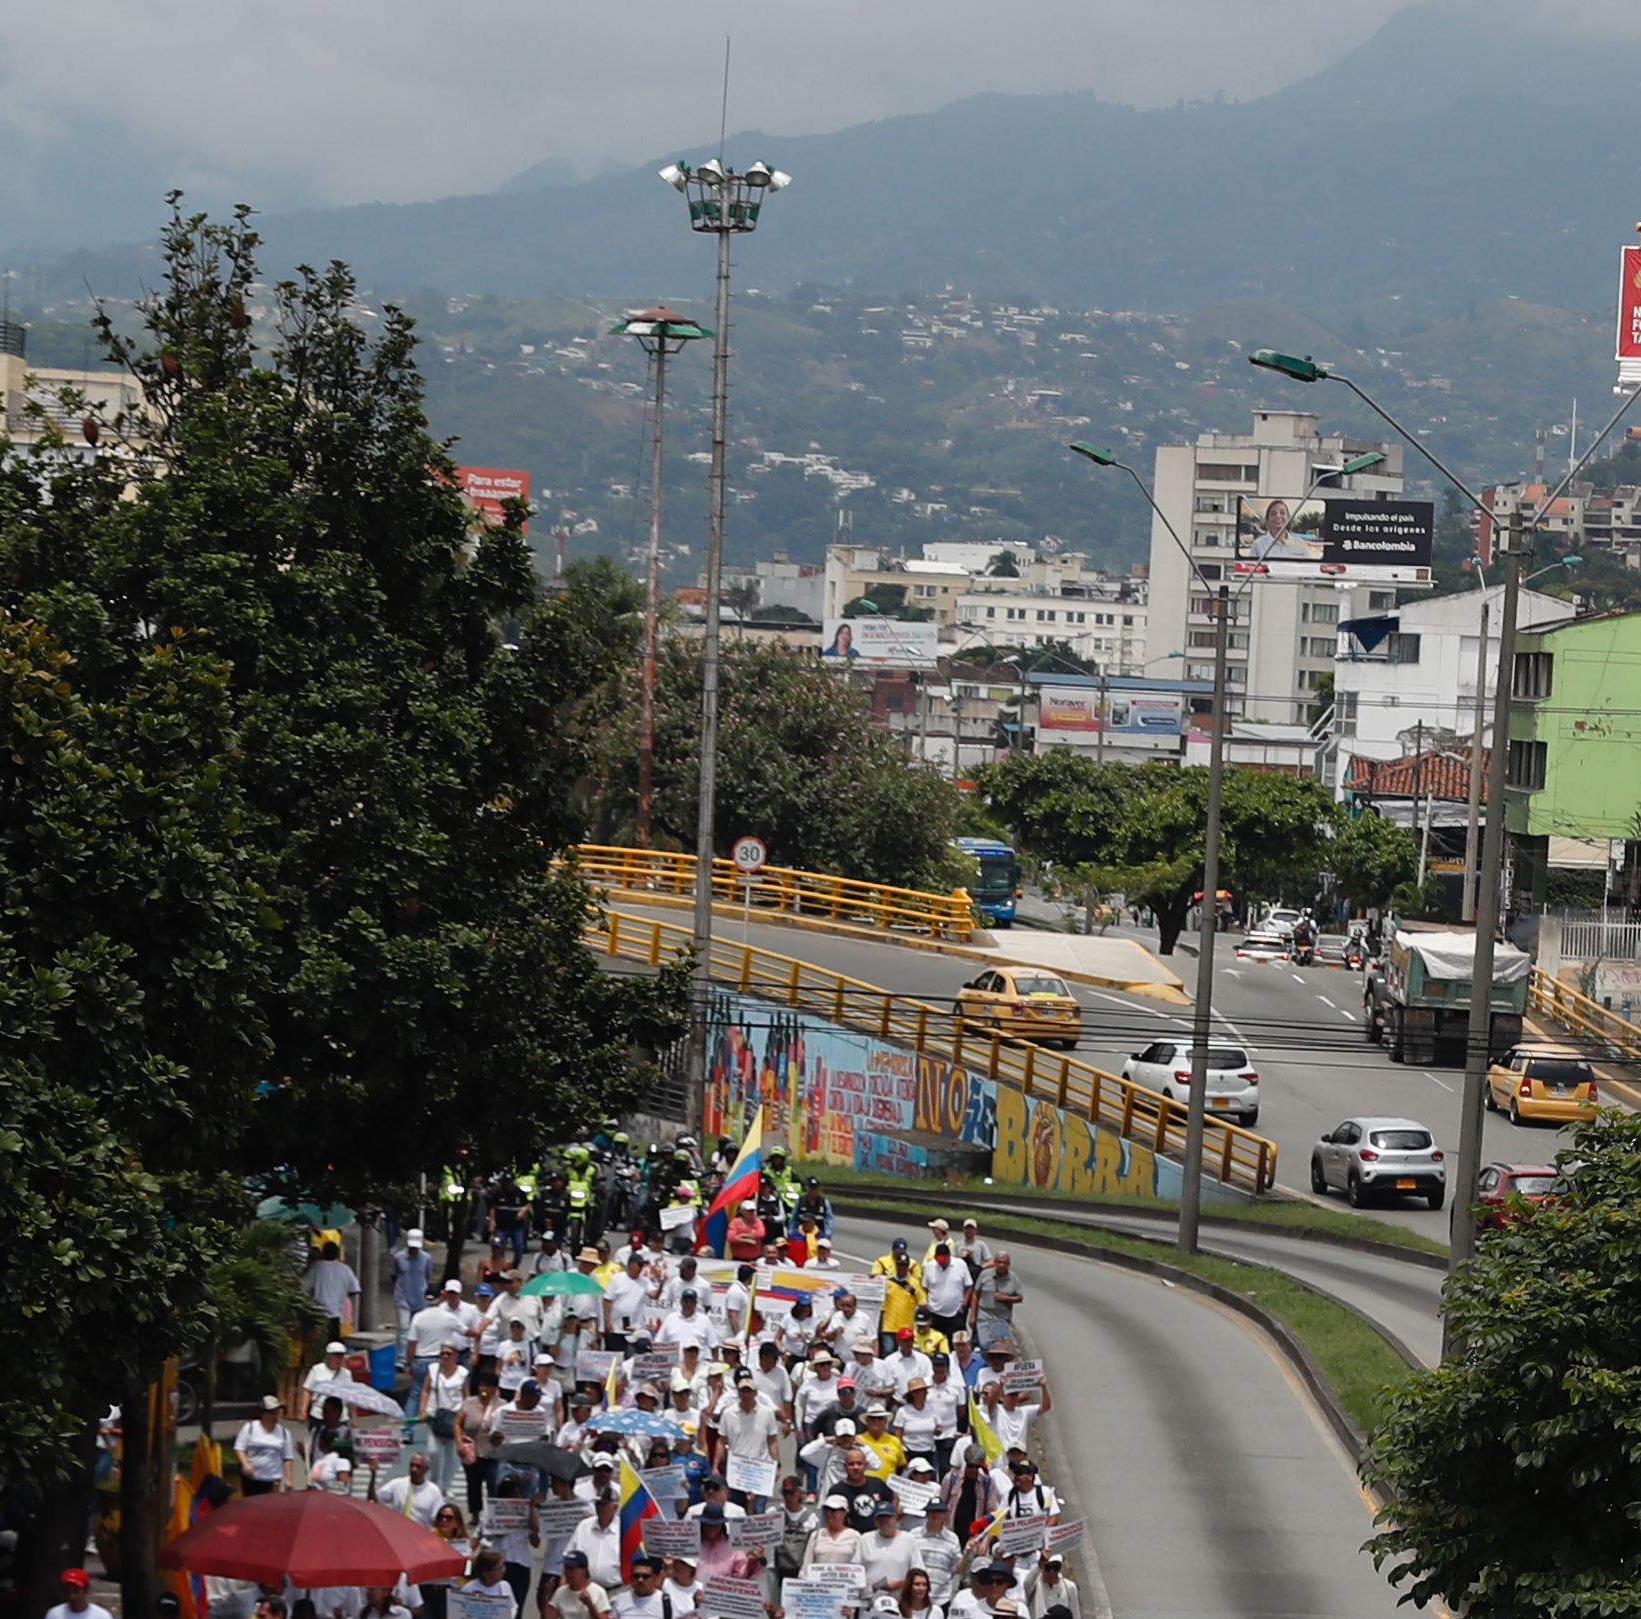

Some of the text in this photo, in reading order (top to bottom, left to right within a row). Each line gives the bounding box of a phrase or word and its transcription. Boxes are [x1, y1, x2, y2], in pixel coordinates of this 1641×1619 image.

[467, 473, 492, 486] Para
[1333, 523, 1363, 533] Desde
[1365, 523, 1379, 533] los
[1353, 539, 1416, 552] Bancolombia
[739, 846, 760, 862] 30
[915, 1055, 969, 1137] NO
